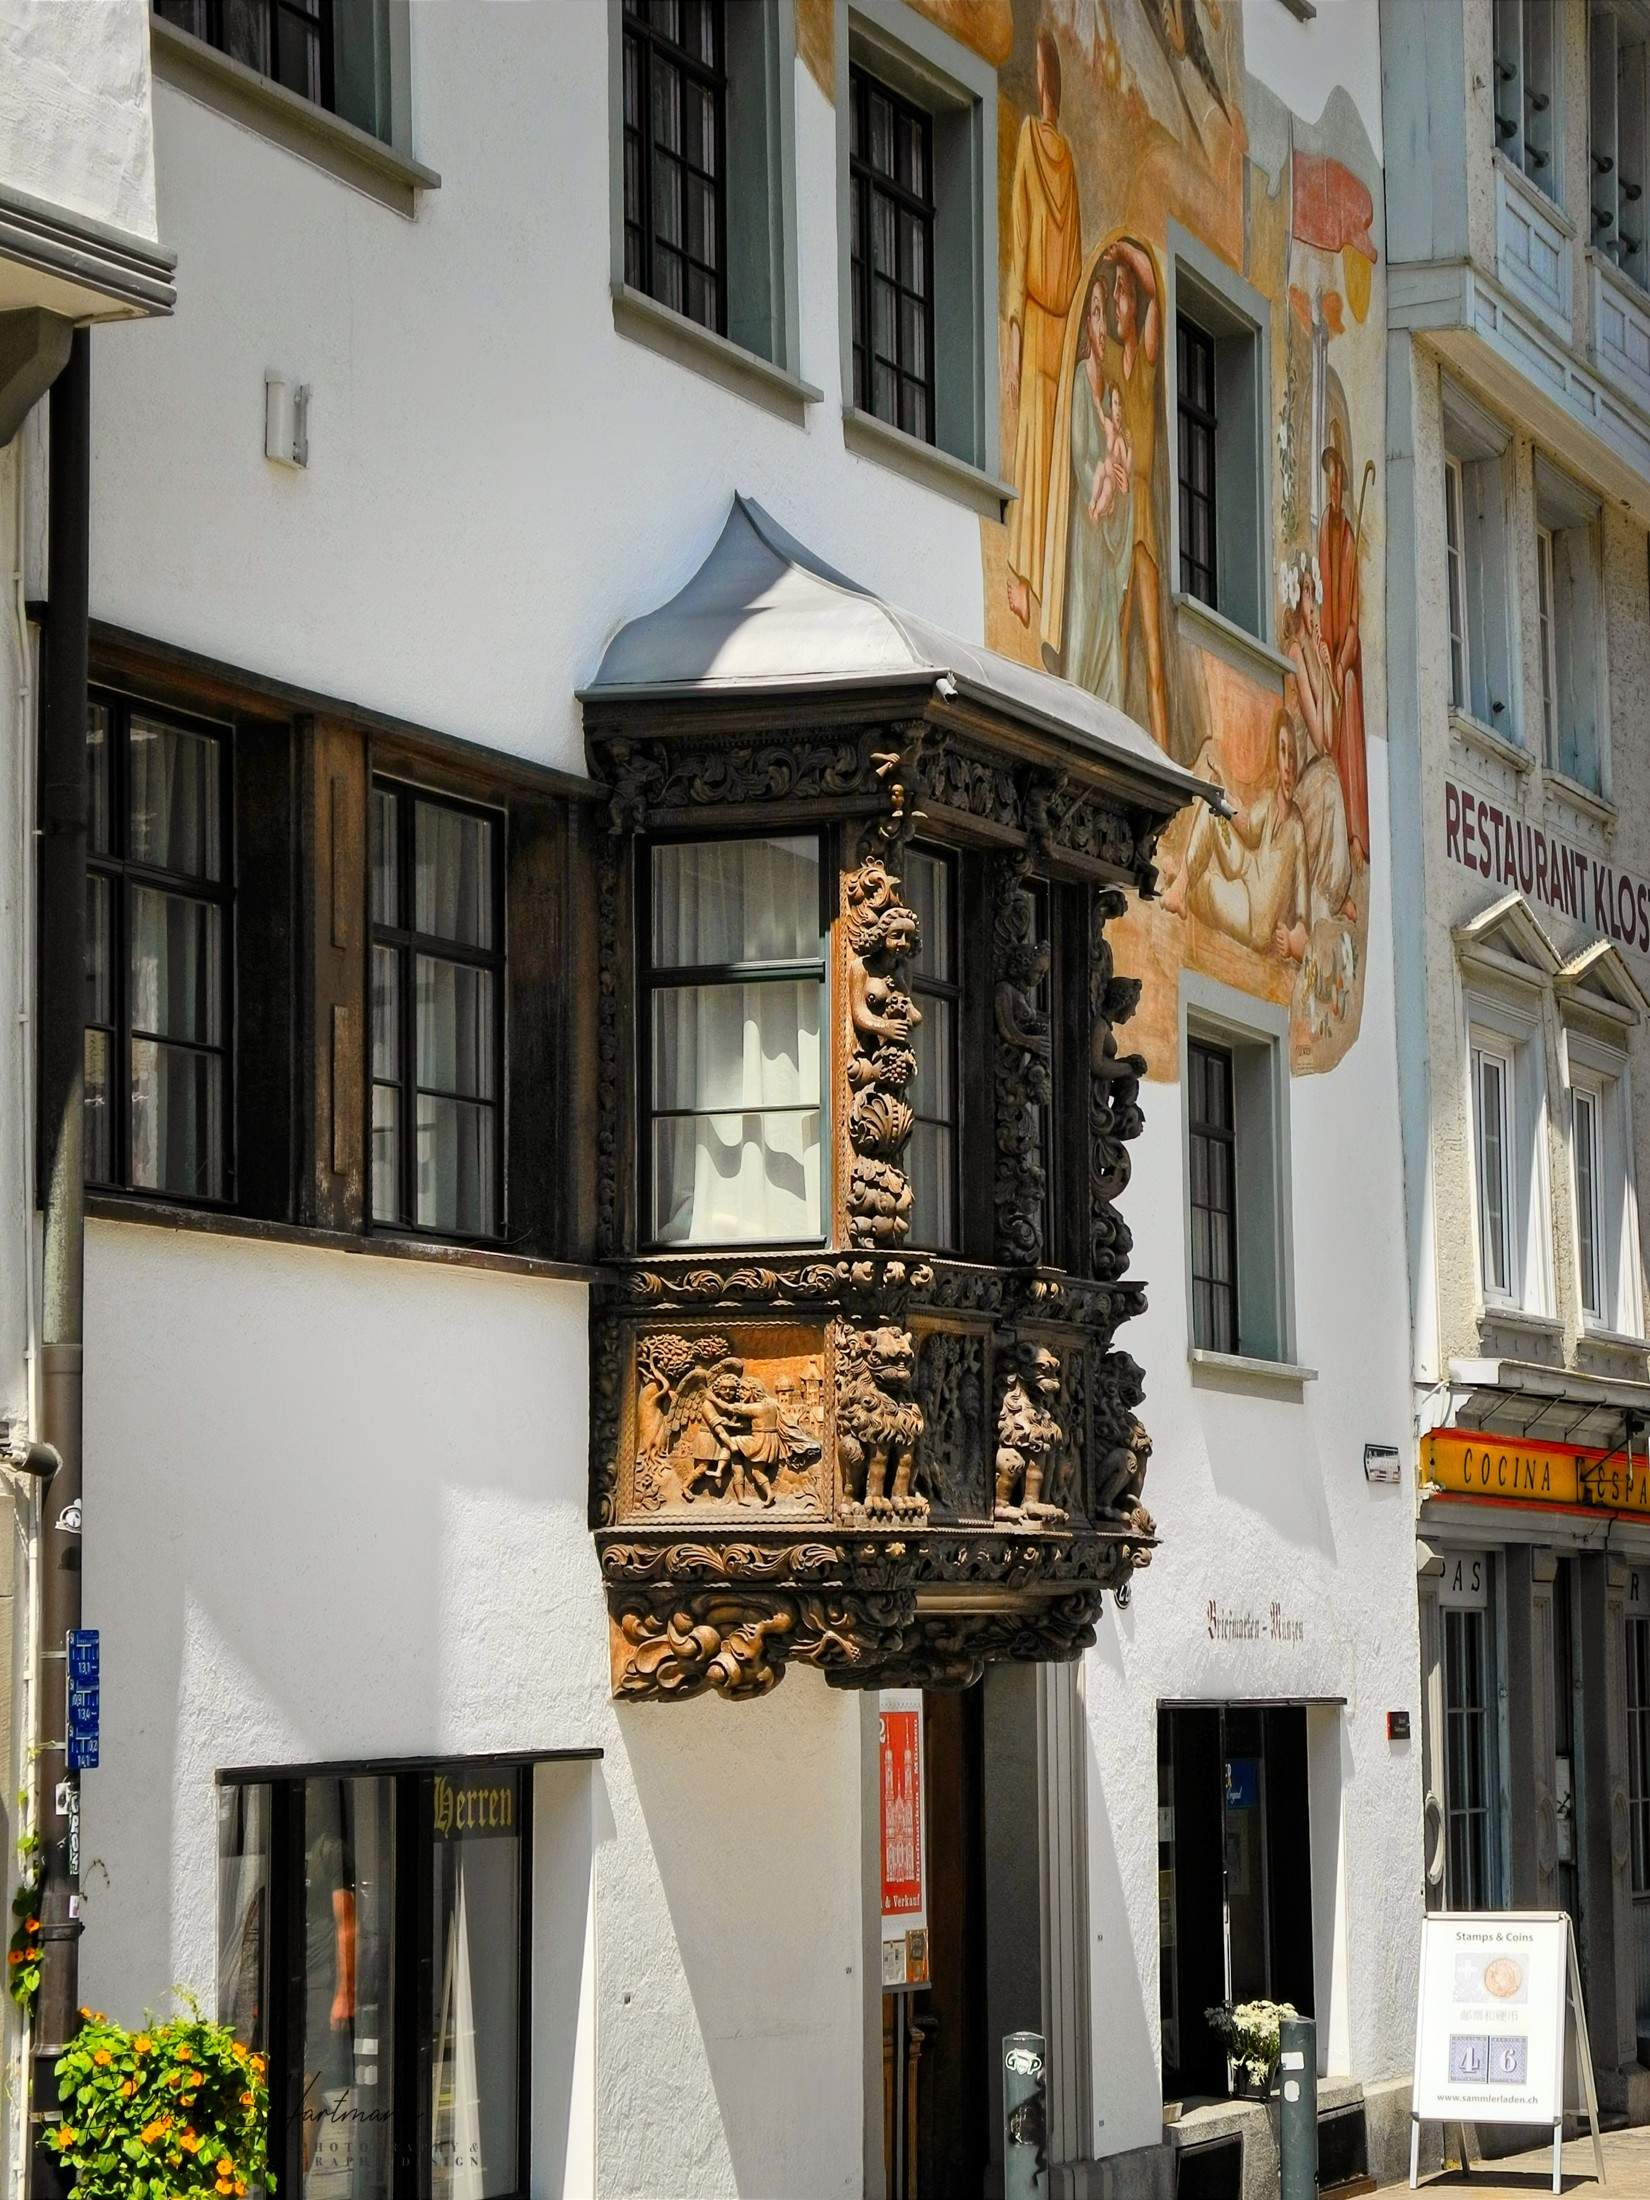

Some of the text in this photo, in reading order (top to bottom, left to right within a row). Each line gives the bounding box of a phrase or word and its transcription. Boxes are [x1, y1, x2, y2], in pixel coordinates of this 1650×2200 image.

[1445, 780, 1650, 953] RESTAURANT KLOS
[1463, 1447, 1550, 1491] COCINA
[434, 1776, 512, 1839] Herren
[893, 1893, 920, 1908] Verkauf
[1456, 1931, 1534, 1943] Stamps & Coins
[1459, 2046, 1480, 2074] 4
[1500, 2047, 1518, 2073] 6
[1437, 2094, 1539, 2104] www.sammlerladen.ch
